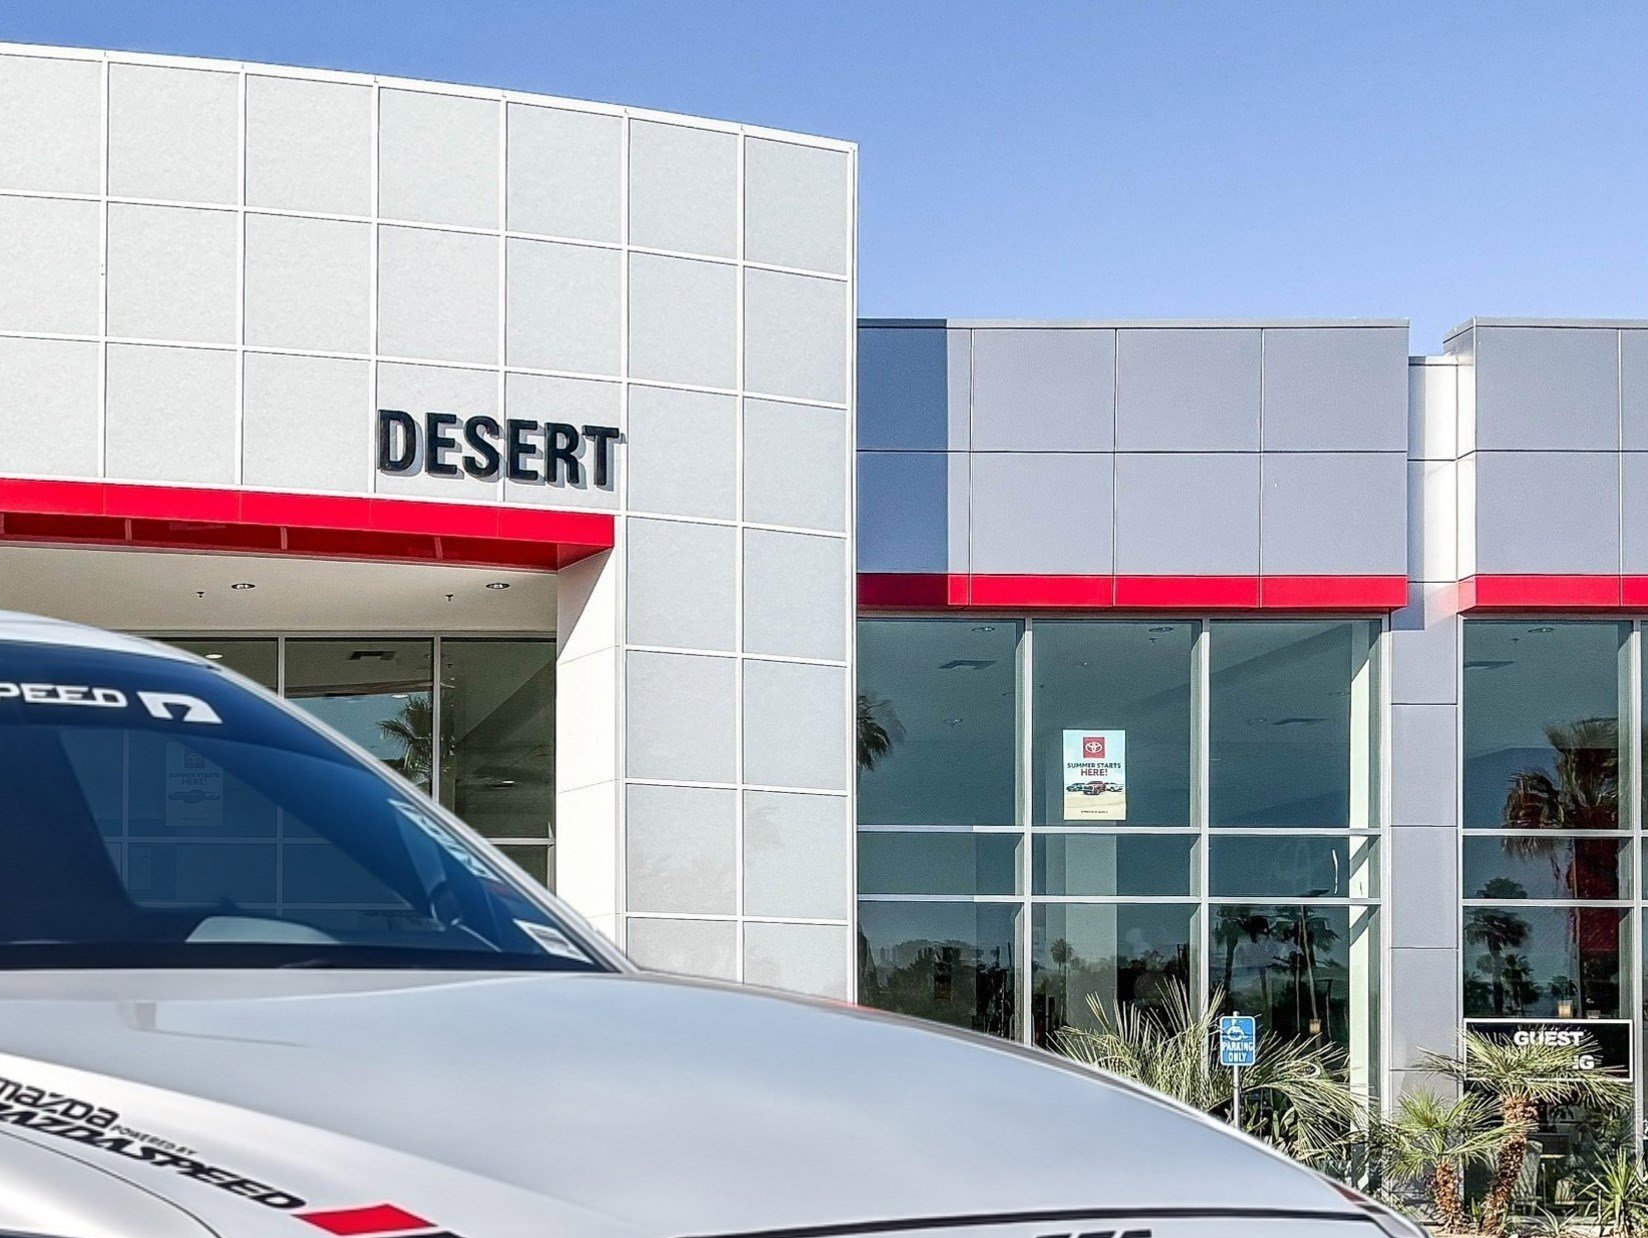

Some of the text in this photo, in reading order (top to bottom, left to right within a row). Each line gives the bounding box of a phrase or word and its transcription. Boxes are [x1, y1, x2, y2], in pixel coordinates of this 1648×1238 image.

[377, 409, 620, 487] DESERT
[1080, 768, 1108, 777] HERE!
[1513, 1030, 1584, 1047] GUEST
[1222, 1041, 1253, 1052] PARKING
[1228, 1051, 1247, 1062] ONLY
